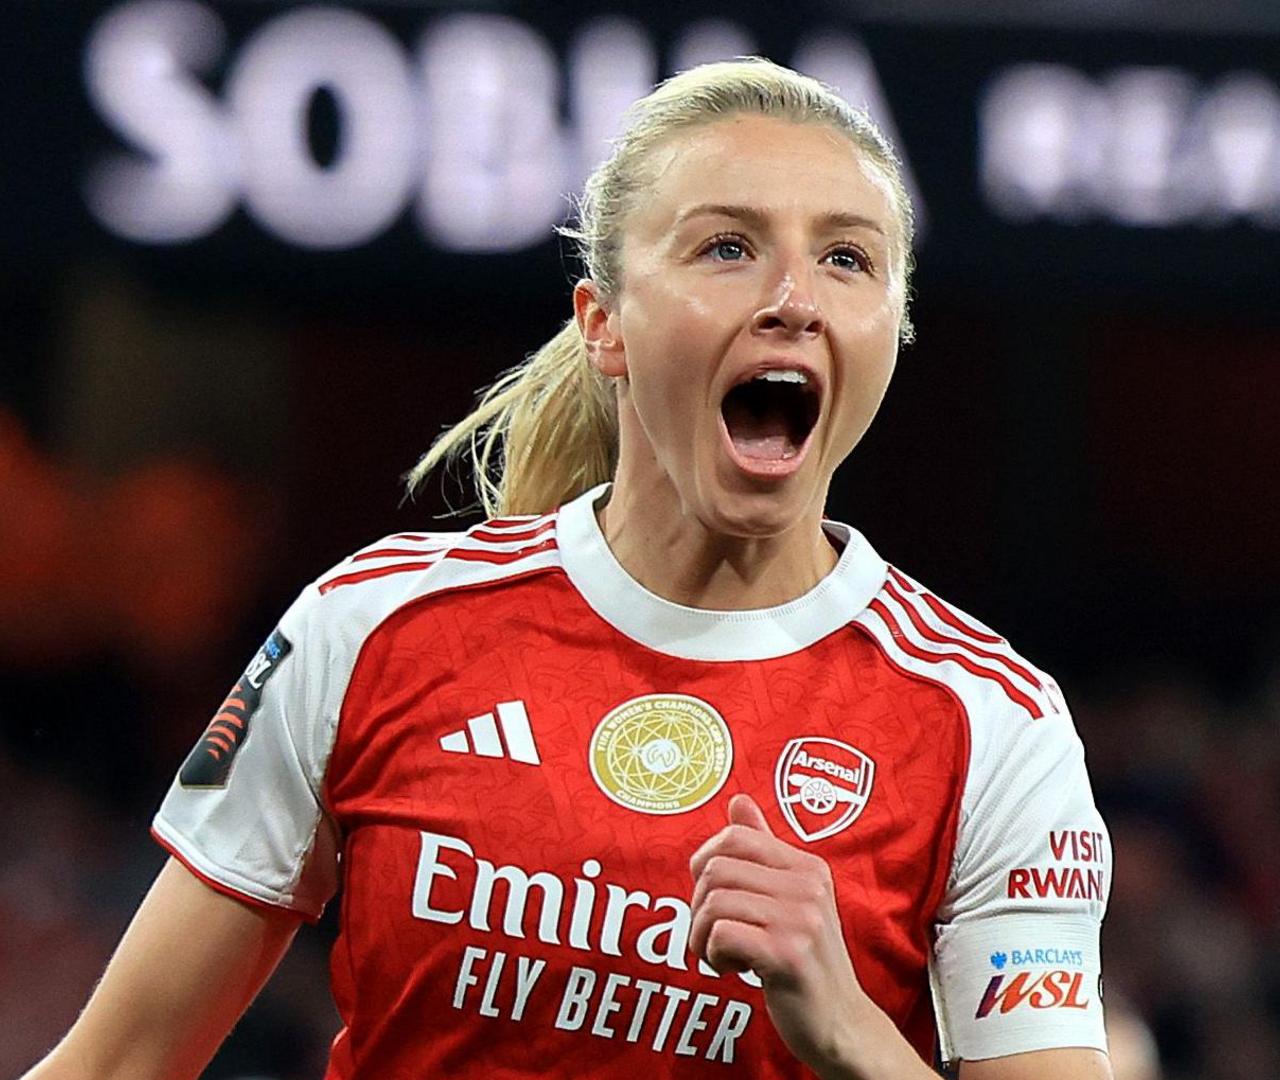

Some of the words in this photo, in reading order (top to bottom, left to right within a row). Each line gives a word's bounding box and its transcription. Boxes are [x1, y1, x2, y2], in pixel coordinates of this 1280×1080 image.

[793, 750, 860, 784] Arsenal
[1049, 830, 1103, 863] VISIT
[412, 831, 763, 988] Emira
[1011, 948, 1082, 967] BARCLAYS
[452, 946, 546, 1021] FLY
[555, 966, 752, 1064] BETTER
[975, 970, 1089, 1020] WSL
